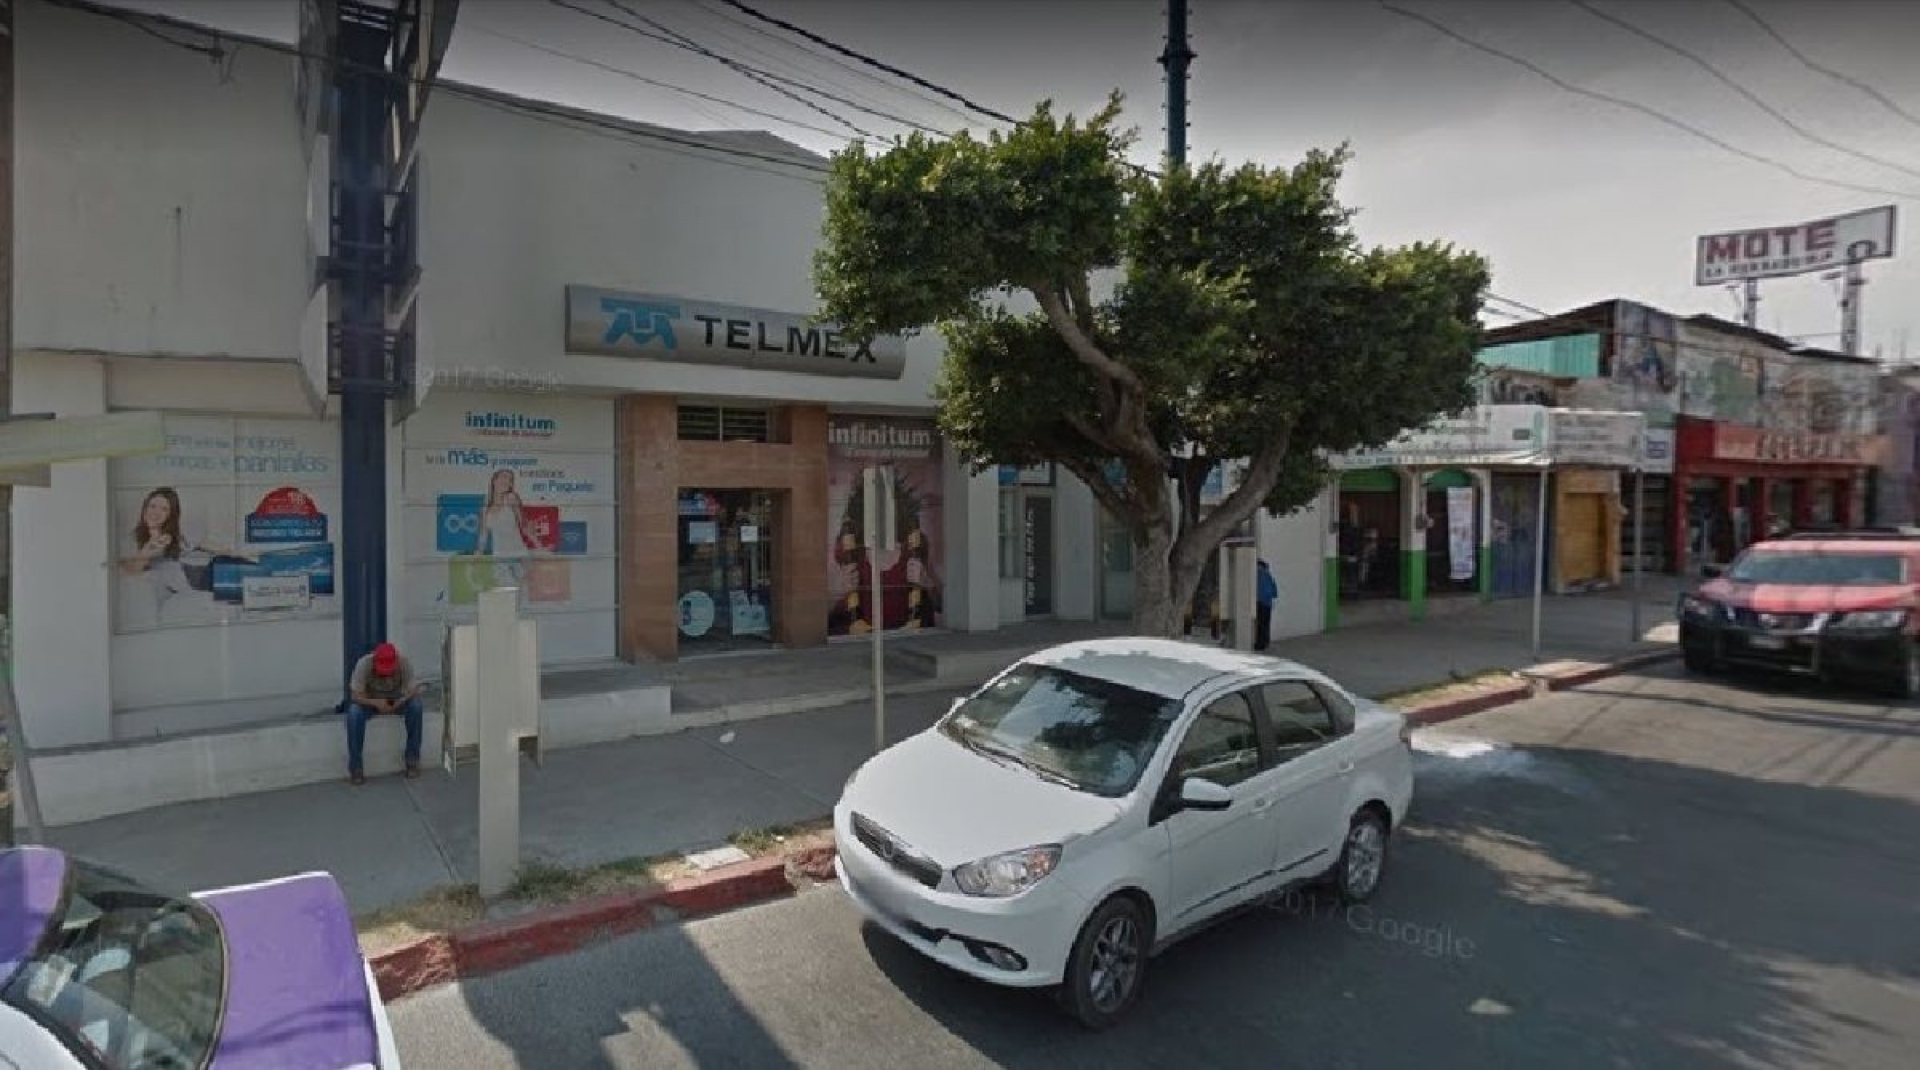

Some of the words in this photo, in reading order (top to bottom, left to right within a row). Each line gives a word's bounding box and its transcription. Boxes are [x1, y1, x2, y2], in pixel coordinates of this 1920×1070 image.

[1705, 219, 1837, 265] MOTE
[694, 314, 877, 364] TELMEX
[465, 411, 554, 430] infinitum
[828, 421, 930, 446] infinitum
[447, 448, 488, 466] más
